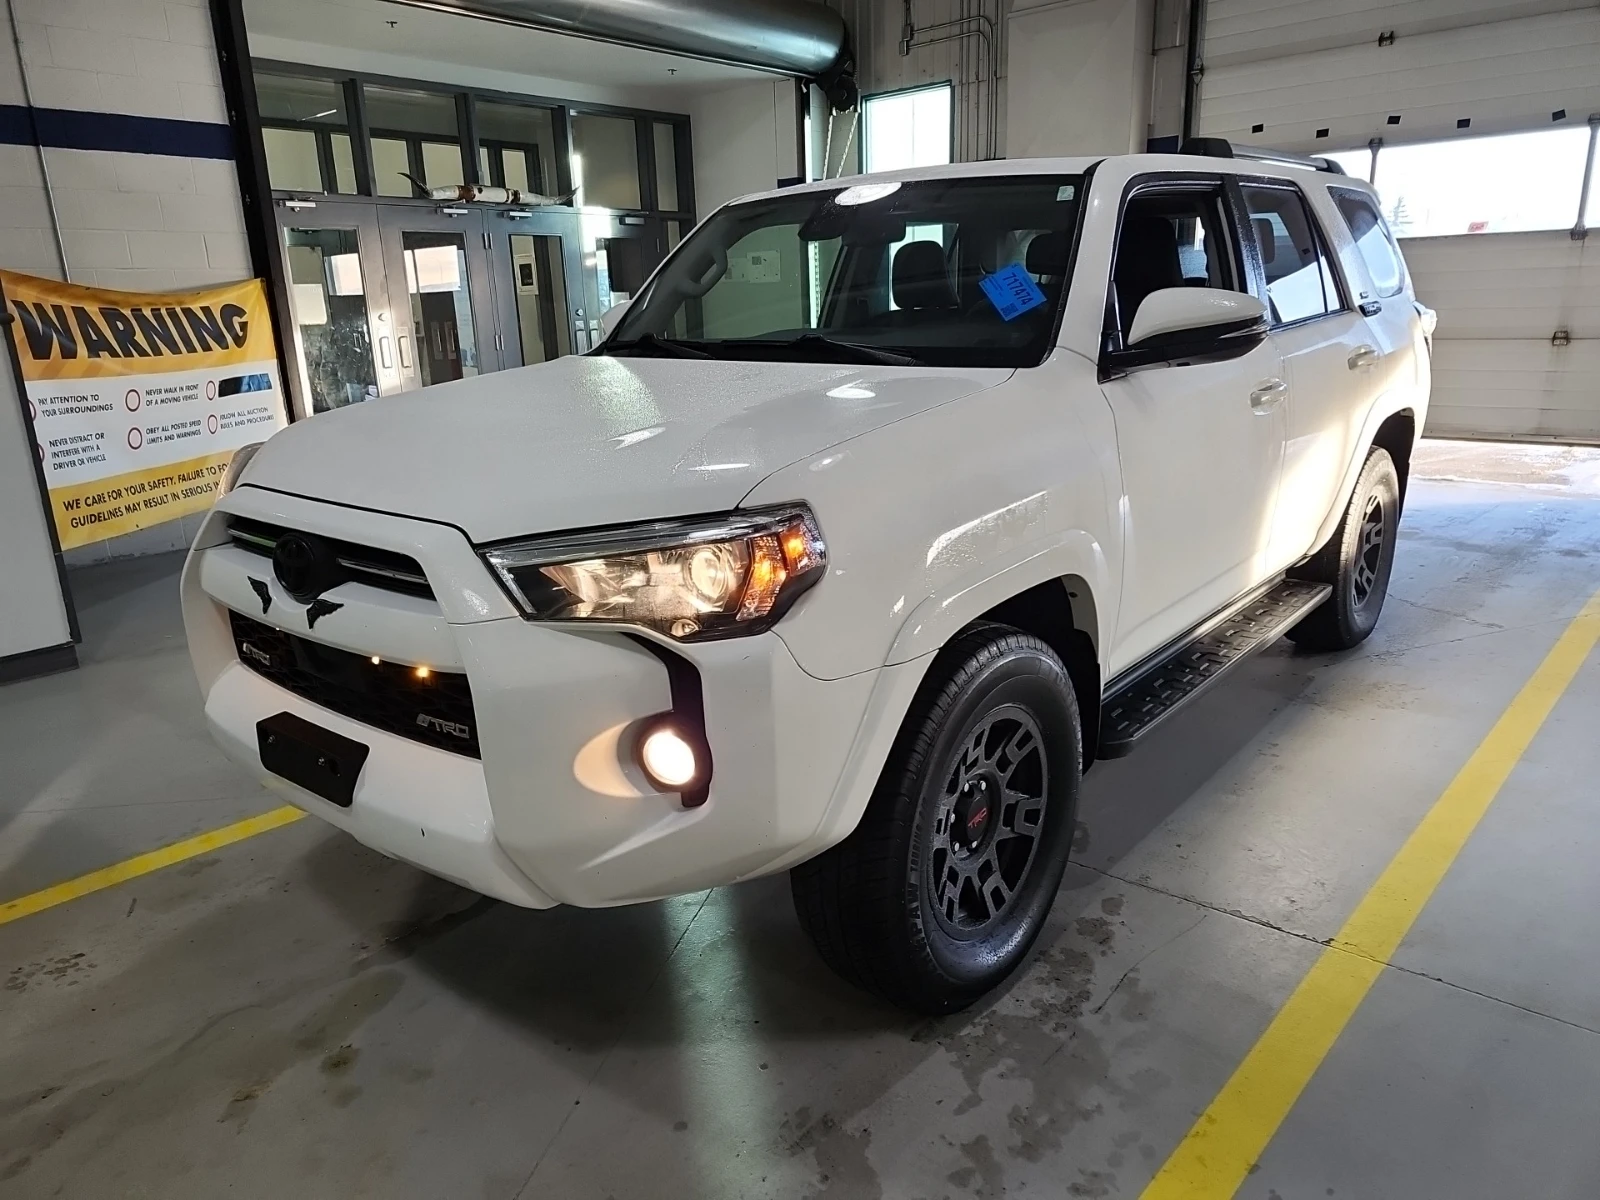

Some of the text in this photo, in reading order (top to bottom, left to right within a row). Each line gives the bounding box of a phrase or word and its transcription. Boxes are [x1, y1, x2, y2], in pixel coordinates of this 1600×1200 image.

[1003, 272, 1034, 306] 717474
[10, 299, 249, 360] WARNING
[146, 388, 162, 396] NEVER
[163, 386, 178, 394] WALK
[185, 383, 199, 392] FRONT
[38, 398, 48, 406] PAY
[50, 394, 88, 405] ATTENTION
[145, 399, 153, 407] OF
[160, 395, 181, 405] MOVING
[182, 393, 199, 402] VEHICLE
[41, 403, 114, 417] YOUR SURROUNDINGS
[246, 406, 269, 415] AUCTION
[145, 426, 160, 435] OBEY
[170, 421, 188, 430] POSTED
[188, 419, 202, 428] SPEED
[234, 419, 246, 427] AND
[49, 432, 105, 448] NEVER DISTRACT OR
[146, 428, 202, 445] LIMITS AND WARNINGS
[51, 447, 80, 459] INTERFERE
[80, 445, 95, 454] WITH
[53, 453, 107, 470] DRIVER OR VEHICLE
[63, 498, 82, 512] WE
[84, 491, 108, 508] CARE
[107, 488, 123, 502] FOR
[124, 482, 148, 497] YOUR
[147, 475, 177, 491] SAFETY.
[177, 468, 206, 484] FAILURE
[205, 466, 217, 476] TO
[70, 506, 124, 529] GUIDELINES
[125, 503, 142, 516] MAY
[144, 495, 169, 509] RESULT
[171, 492, 181, 502] IN
[181, 482, 213, 499] SERIOUS
[430, 716, 470, 739] TRD
[910, 823, 922, 873] TOURING
